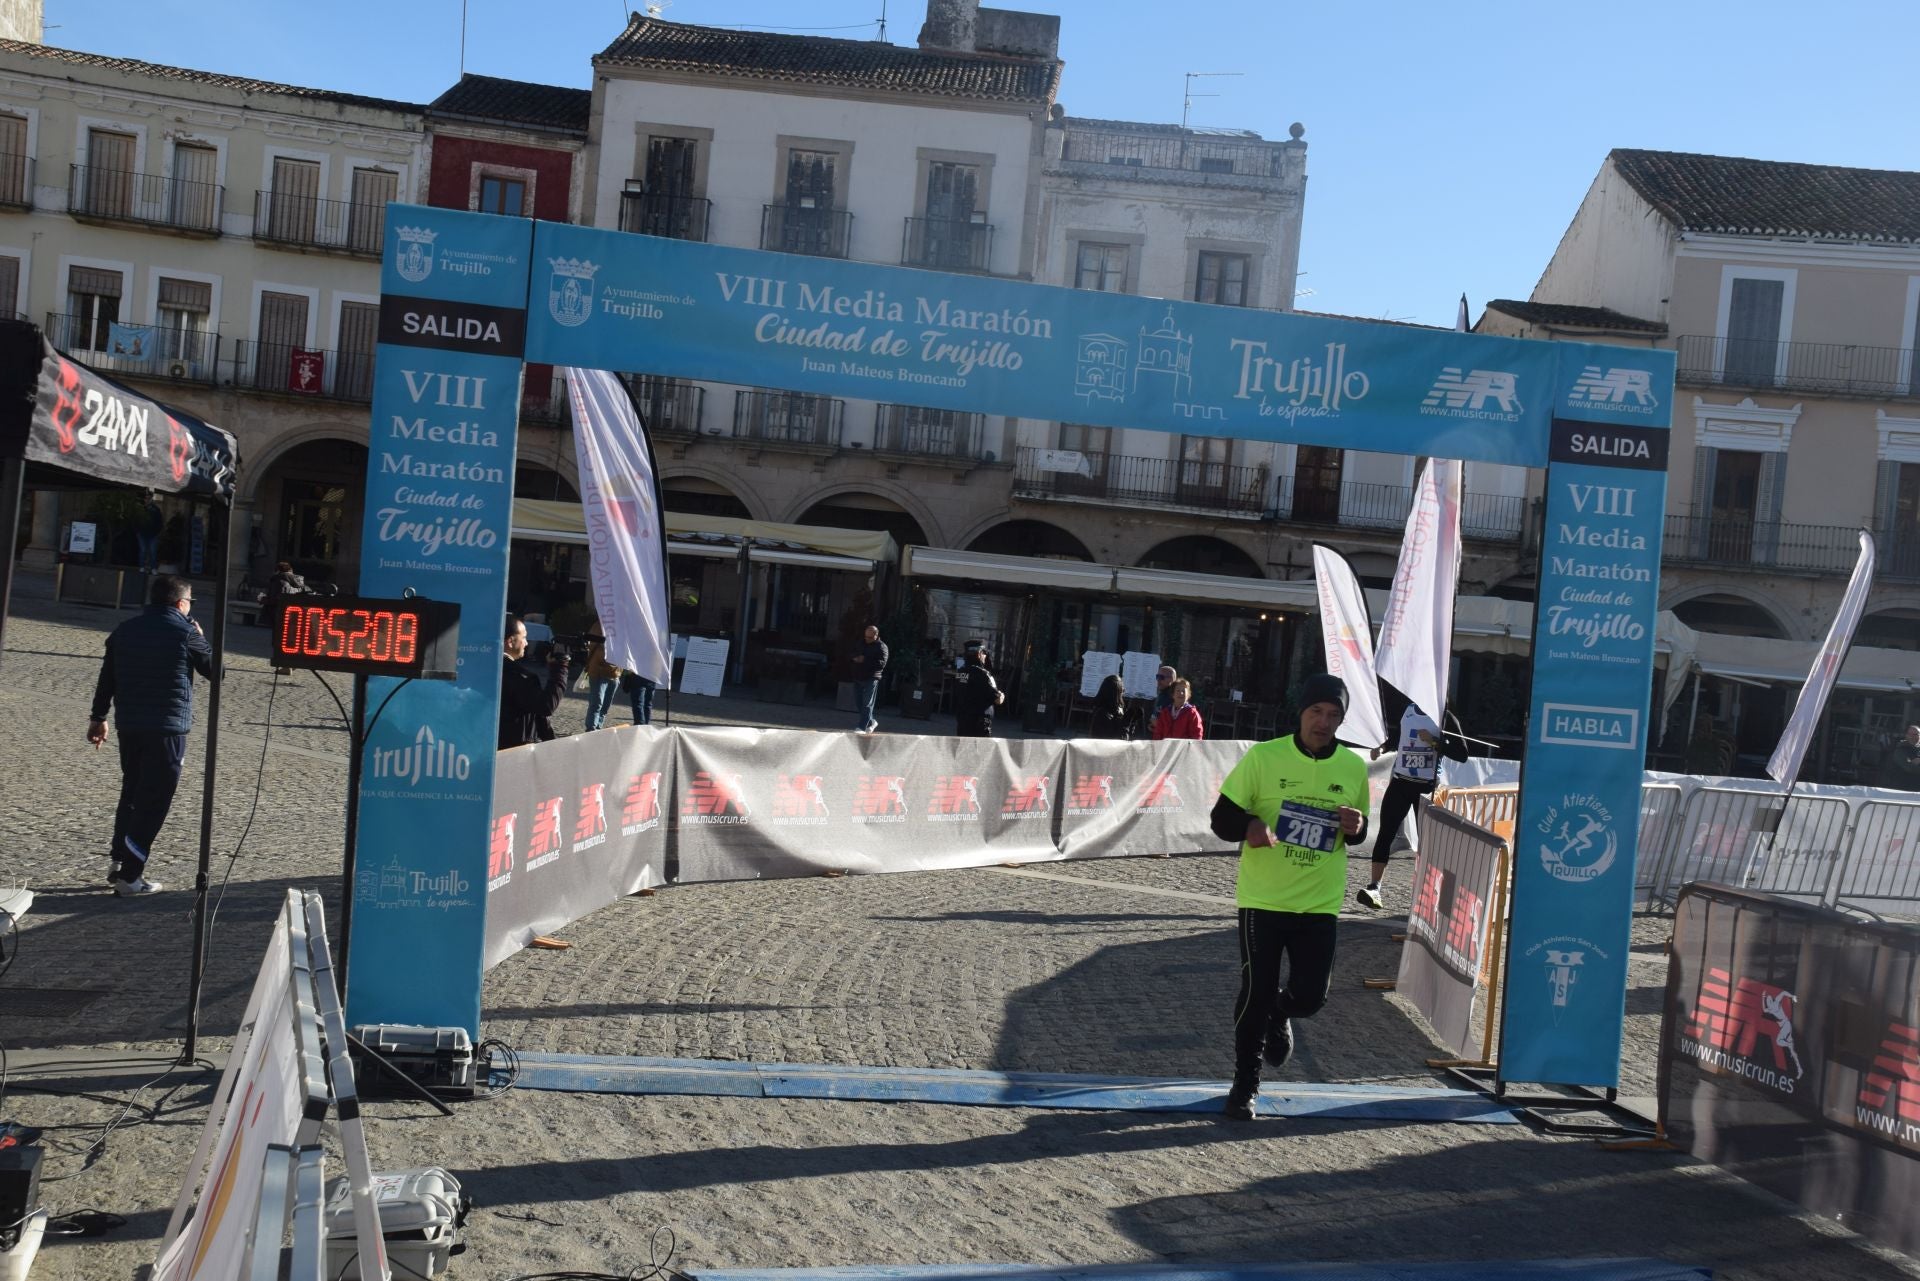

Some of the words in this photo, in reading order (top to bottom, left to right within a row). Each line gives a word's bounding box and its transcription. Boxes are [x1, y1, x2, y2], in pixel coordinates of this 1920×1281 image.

[439, 259, 491, 276] Trujillo
[441, 248, 503, 263] Ayuntamiento
[506, 255, 517, 265] de
[603, 285, 680, 305] Ayuntamiento
[682, 295, 696, 306] de
[715, 272, 787, 309] VIII
[797, 282, 905, 323] Media
[914, 297, 1053, 339] Maratón
[602, 299, 664, 320] Trujillo
[402, 312, 501, 342] SALIDA
[755, 312, 867, 352] Ciudad
[871, 328, 911, 357] de
[919, 329, 1024, 376] Trujillo
[801, 356, 836, 374] Juan
[840, 361, 894, 380] Mateos
[898, 368, 967, 388] Broncano
[1230, 338, 1370, 412] Trujillo
[401, 370, 487, 410] VIII
[1259, 394, 1273, 417] te
[1420, 405, 1519, 422] www.musicrun.es
[1567, 398, 1654, 415] www.musicrun.es
[389, 415, 499, 448] Media
[1570, 434, 1650, 459] SALIDA
[380, 452, 504, 484] Maratón
[394, 486, 460, 509] Ciudad
[461, 494, 486, 510] de
[1567, 483, 1637, 518] VIII
[376, 508, 497, 556] Trujillo
[1558, 523, 1647, 551] Media
[379, 557, 403, 569] Juan
[405, 559, 442, 571] Mateos
[444, 563, 492, 575] Broncano
[1551, 556, 1651, 583] Maratón
[1560, 585, 1612, 605] Ciudad
[1614, 592, 1633, 606] de
[1547, 605, 1645, 648] Trujillo
[1549, 650, 1569, 660] Juan
[1570, 651, 1600, 662] Mateos
[1601, 654, 1640, 664] Broncano
[1554, 715, 1623, 737] HABLA
[373, 724, 471, 786] trujillo
[1405, 755, 1425, 768] 238
[681, 813, 749, 825] www.musicrun.es
[771, 815, 828, 825] www.musicrun.es
[851, 814, 906, 824] www.musicrun.es
[928, 813, 978, 822] www.musicrun.es
[1001, 811, 1048, 820] www.musicrun.es
[1537, 806, 1558, 834] Club
[1563, 792, 1613, 823] Atletismo
[1285, 819, 1323, 849] 218
[1283, 845, 1321, 863] Trujillo
[1544, 859, 1599, 879] TRUJILLO
[409, 870, 469, 896] Trujillo
[1681, 1037, 1794, 1095] www.musicrun.es
